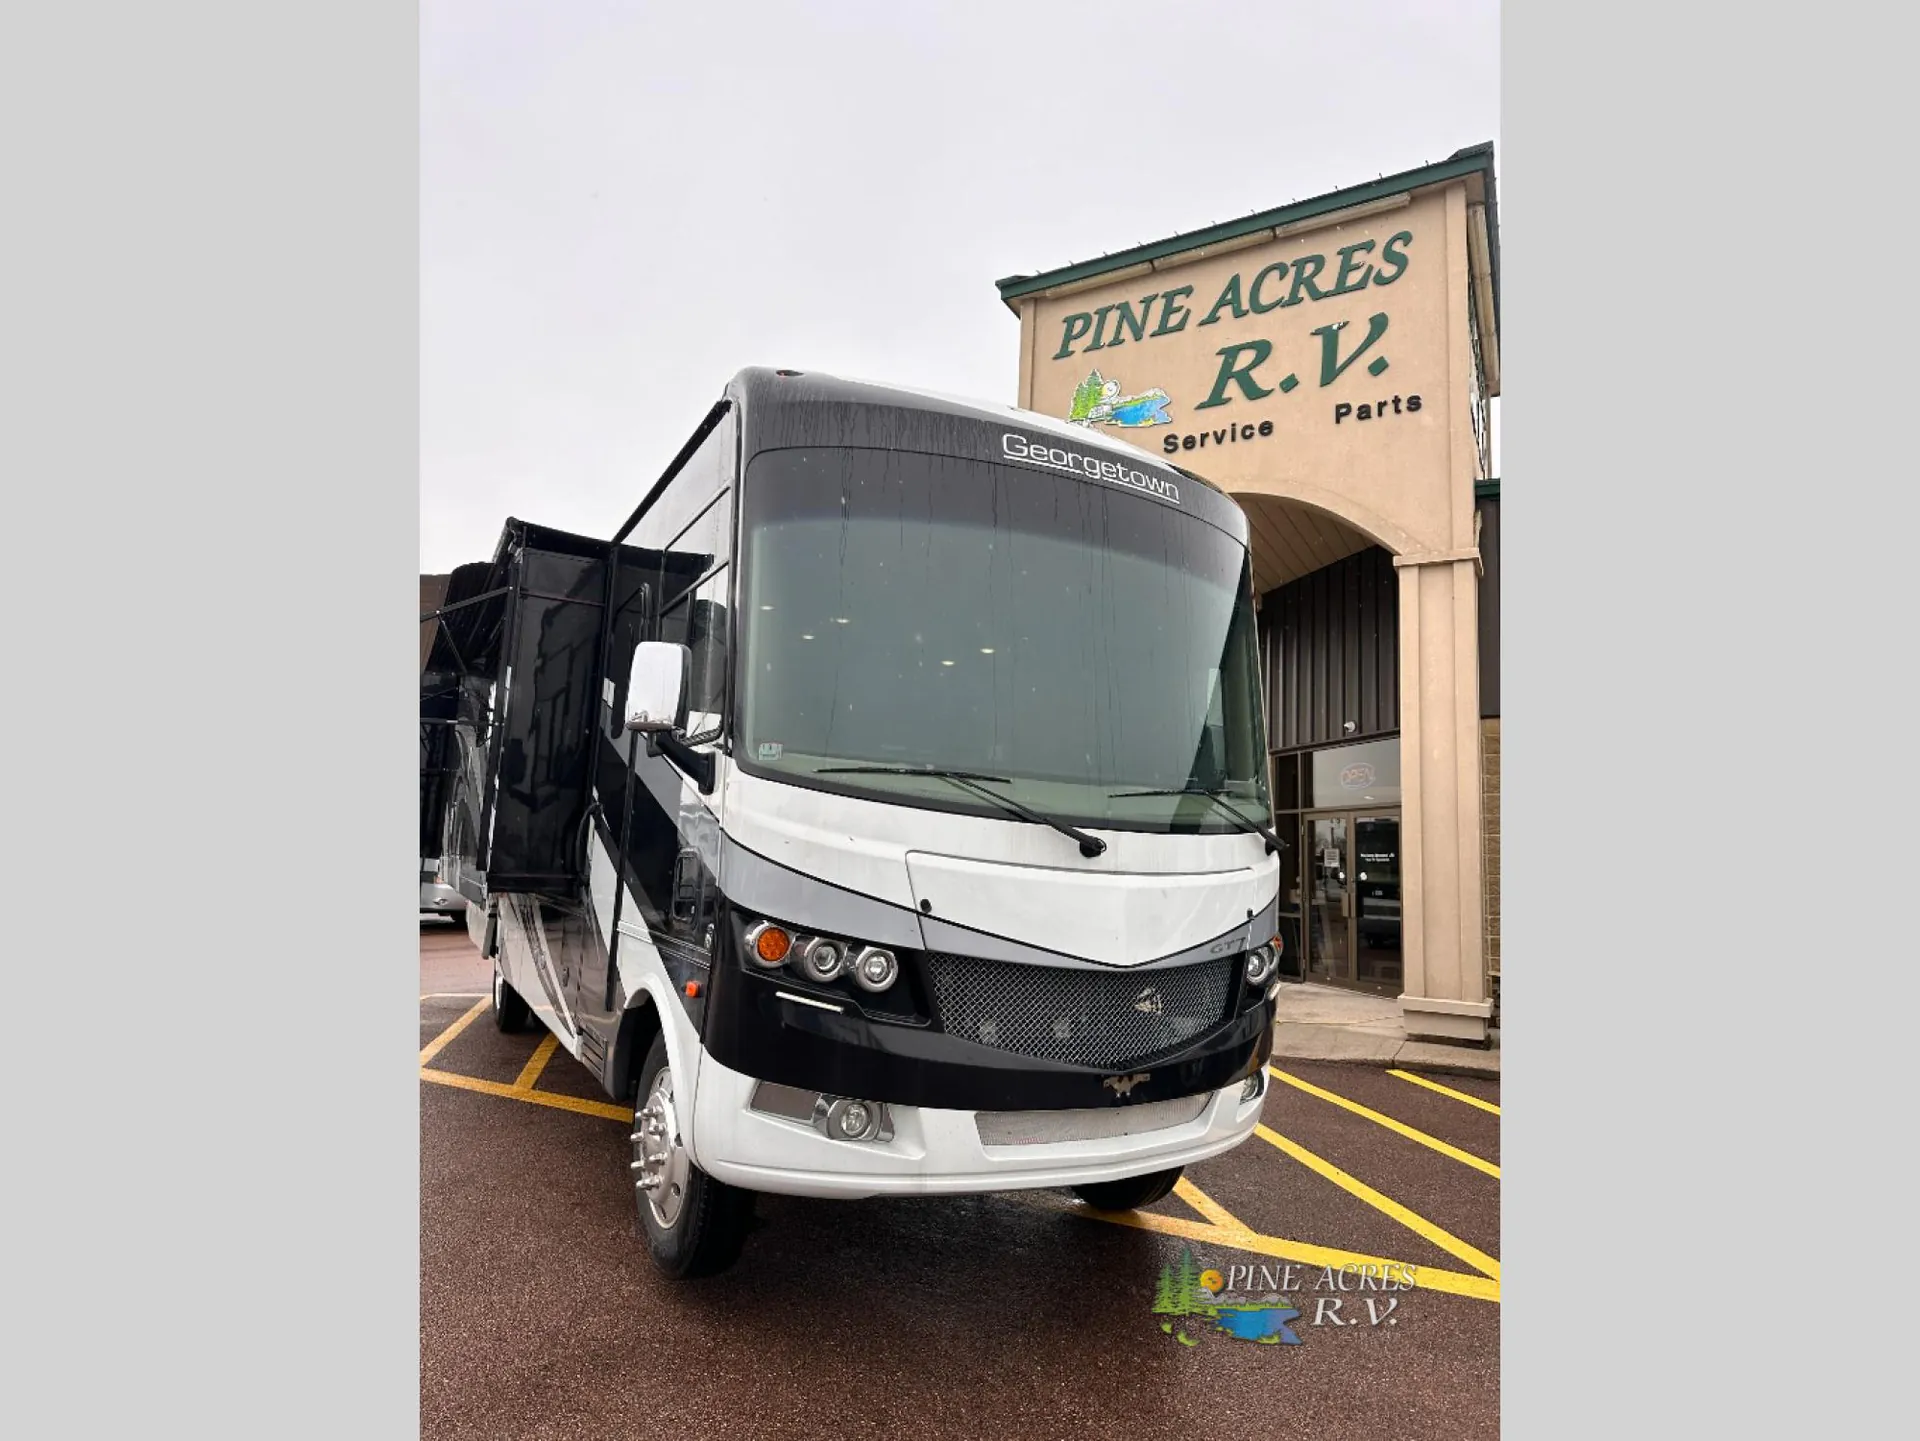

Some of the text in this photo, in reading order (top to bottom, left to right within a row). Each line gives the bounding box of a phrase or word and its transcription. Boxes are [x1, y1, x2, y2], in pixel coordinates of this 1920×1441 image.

[1053, 231, 1413, 360] PINE ACRES
[1163, 394, 1422, 454] Service Parts
[1002, 433, 1181, 500] Georgetown
[1210, 936, 1246, 954] GT7
